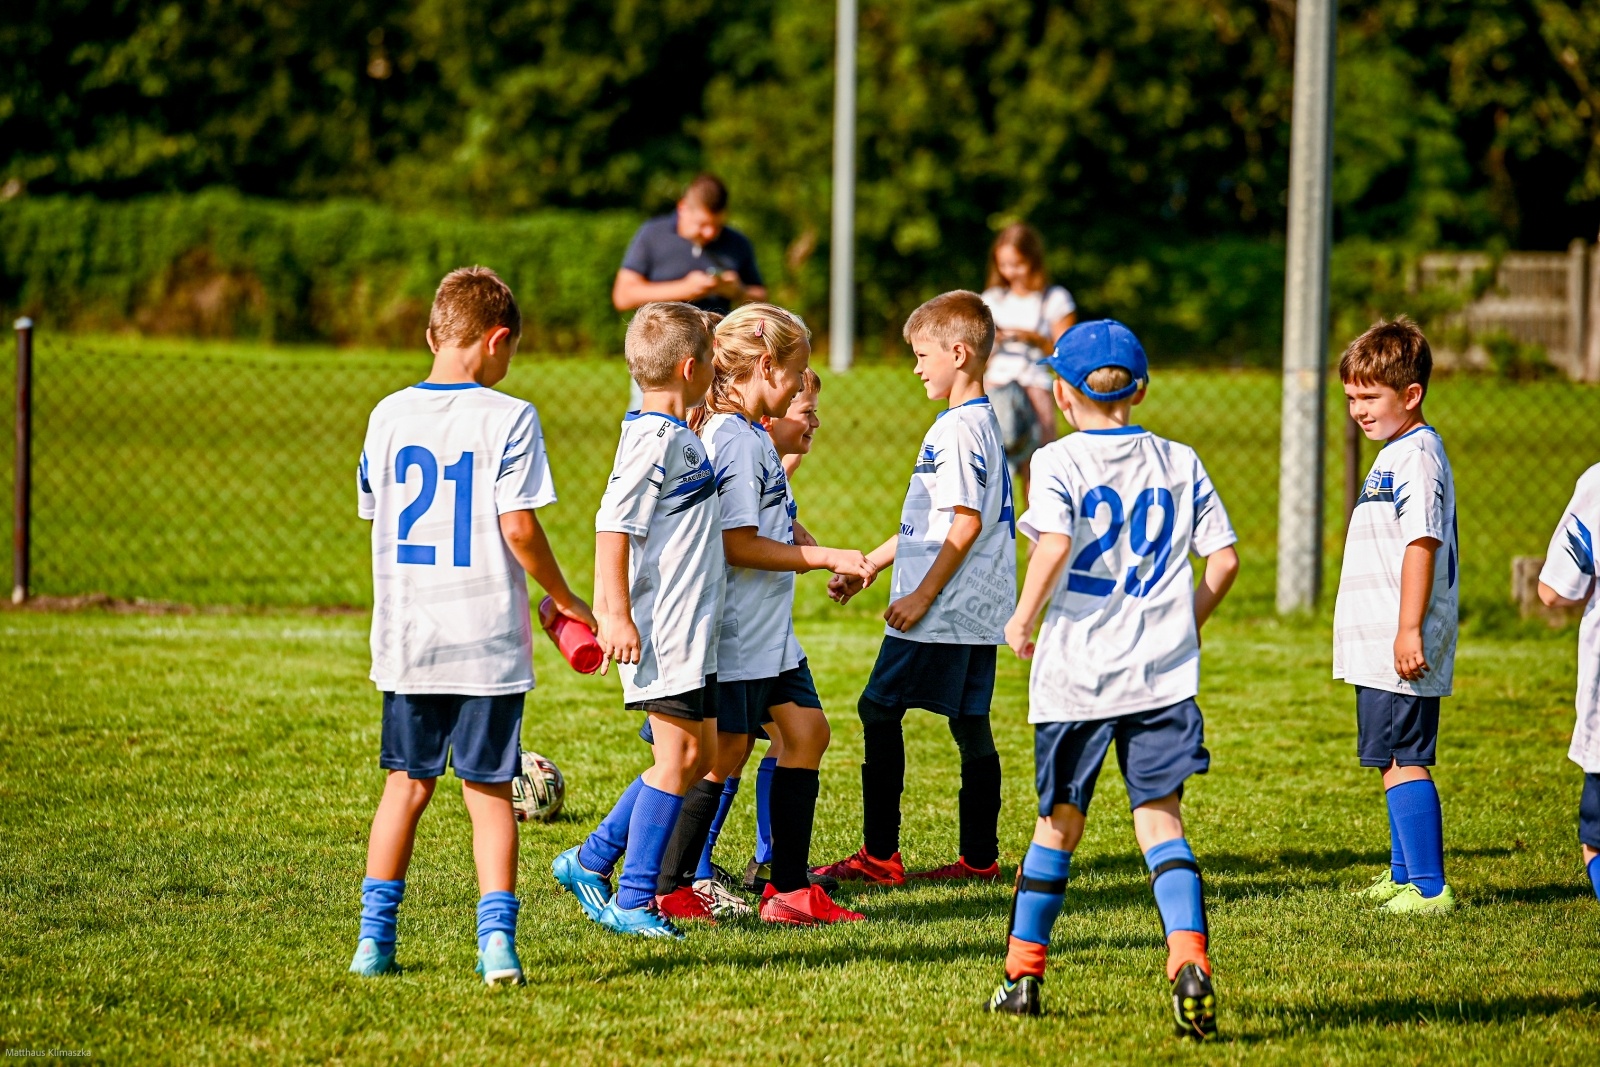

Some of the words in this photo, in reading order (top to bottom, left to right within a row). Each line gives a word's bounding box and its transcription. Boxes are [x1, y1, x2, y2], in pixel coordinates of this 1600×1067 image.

[394, 444, 474, 567] 21
[1067, 485, 1175, 598] 29
[965, 595, 999, 628] GOL
